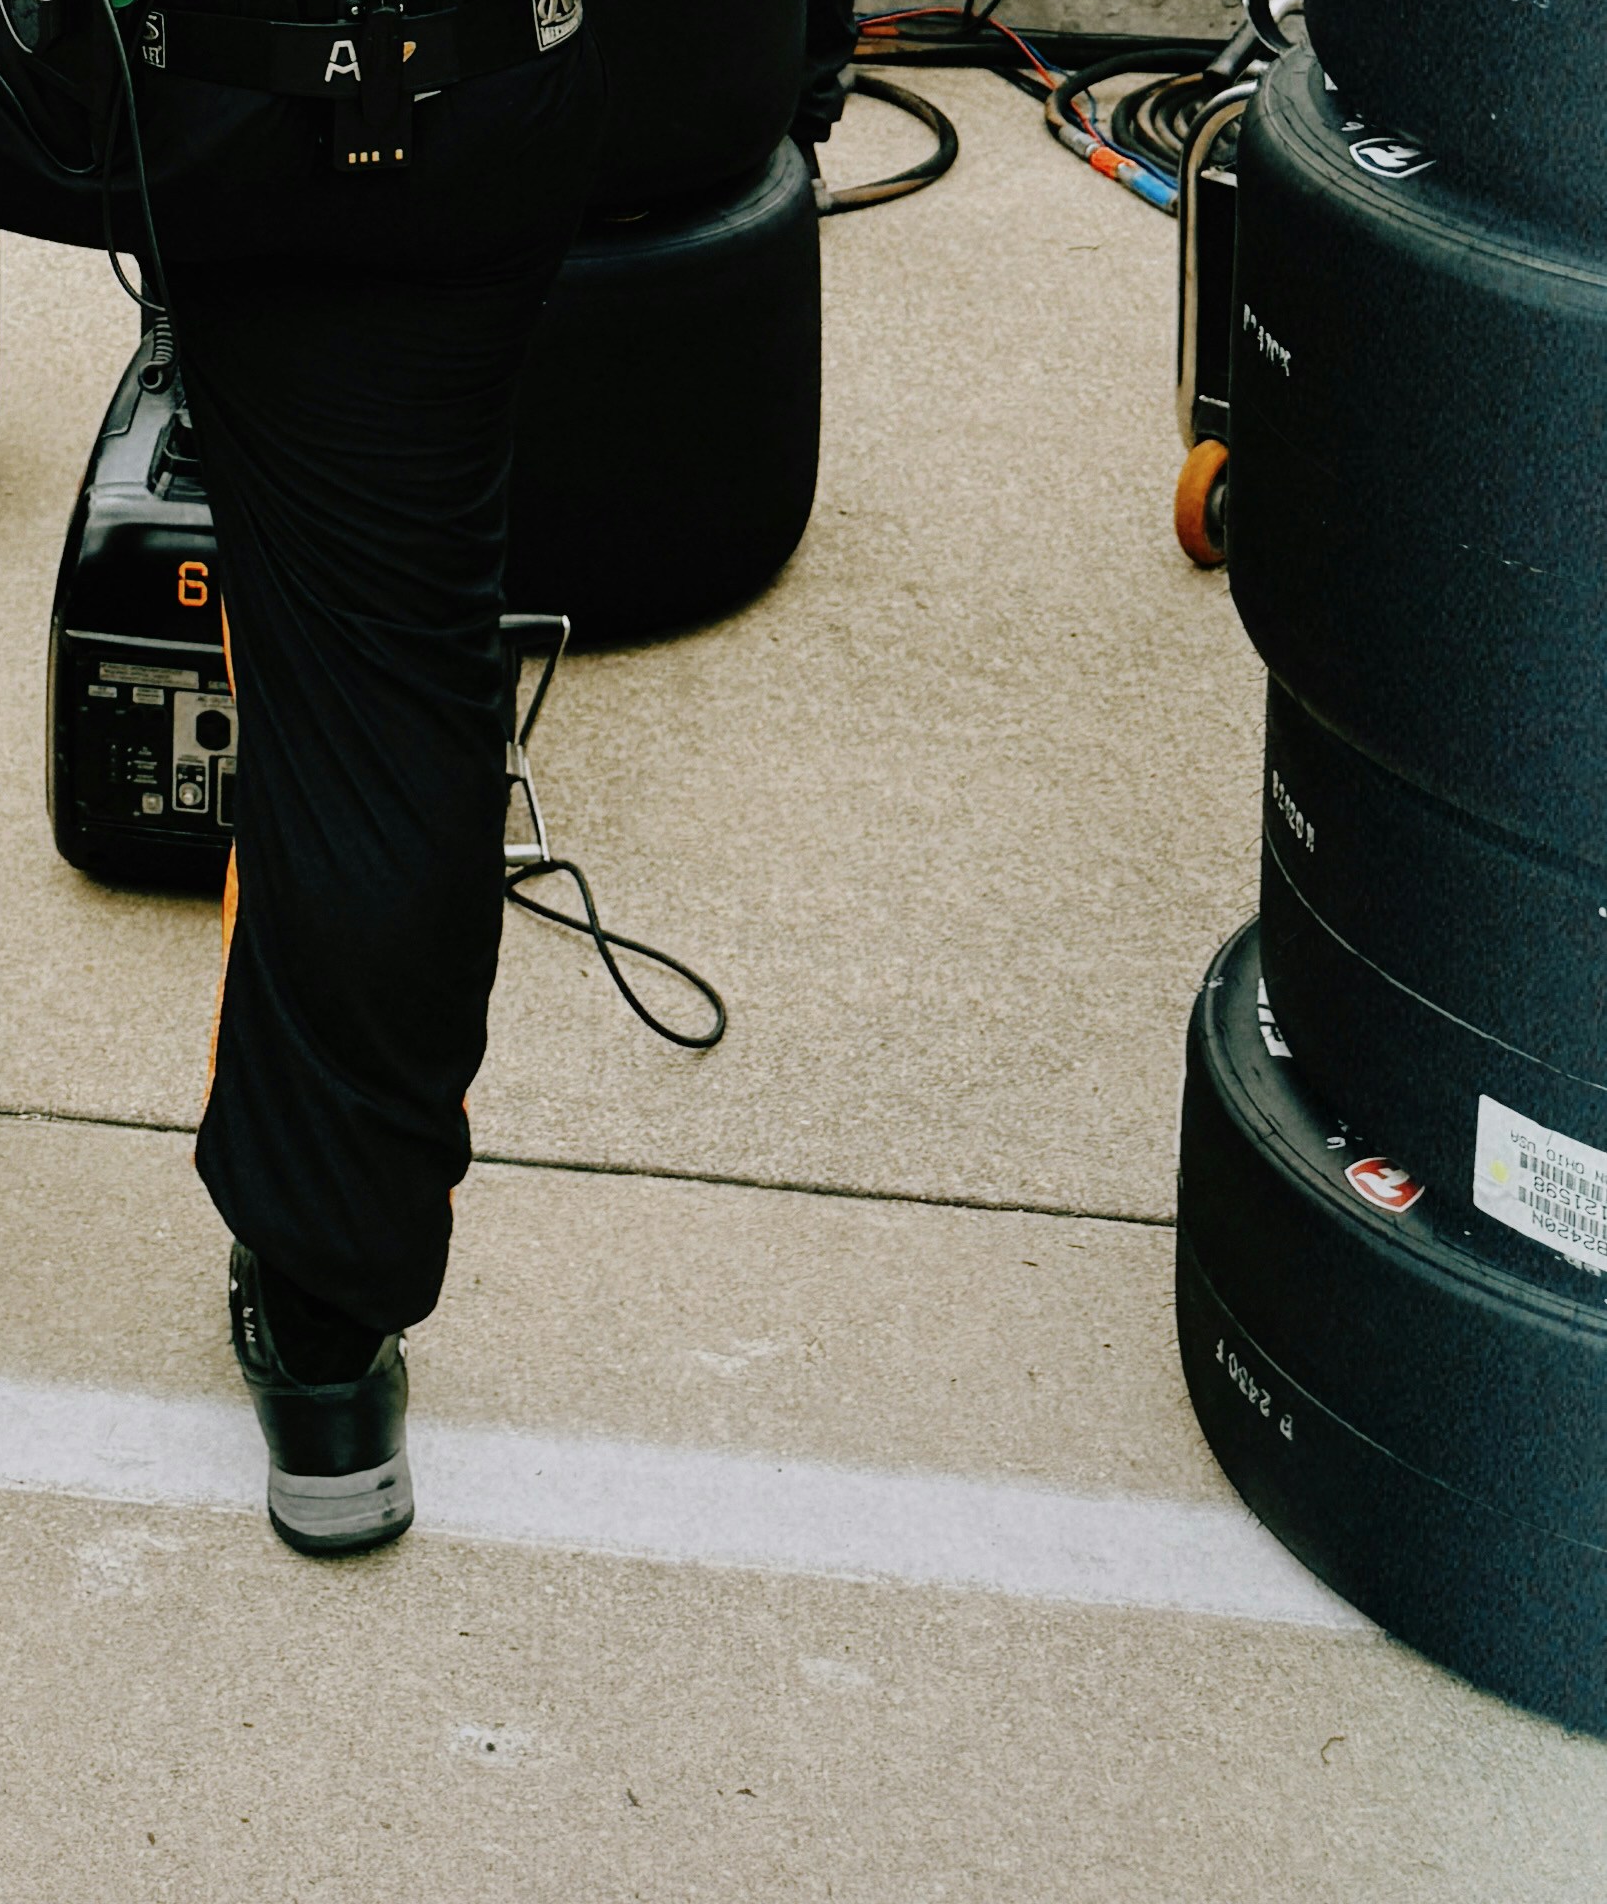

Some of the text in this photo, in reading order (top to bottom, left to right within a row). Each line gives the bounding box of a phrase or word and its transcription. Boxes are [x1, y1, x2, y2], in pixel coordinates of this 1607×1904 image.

[177, 560, 209, 608] 6
[1510, 1129, 1585, 1174] OHIO USA
